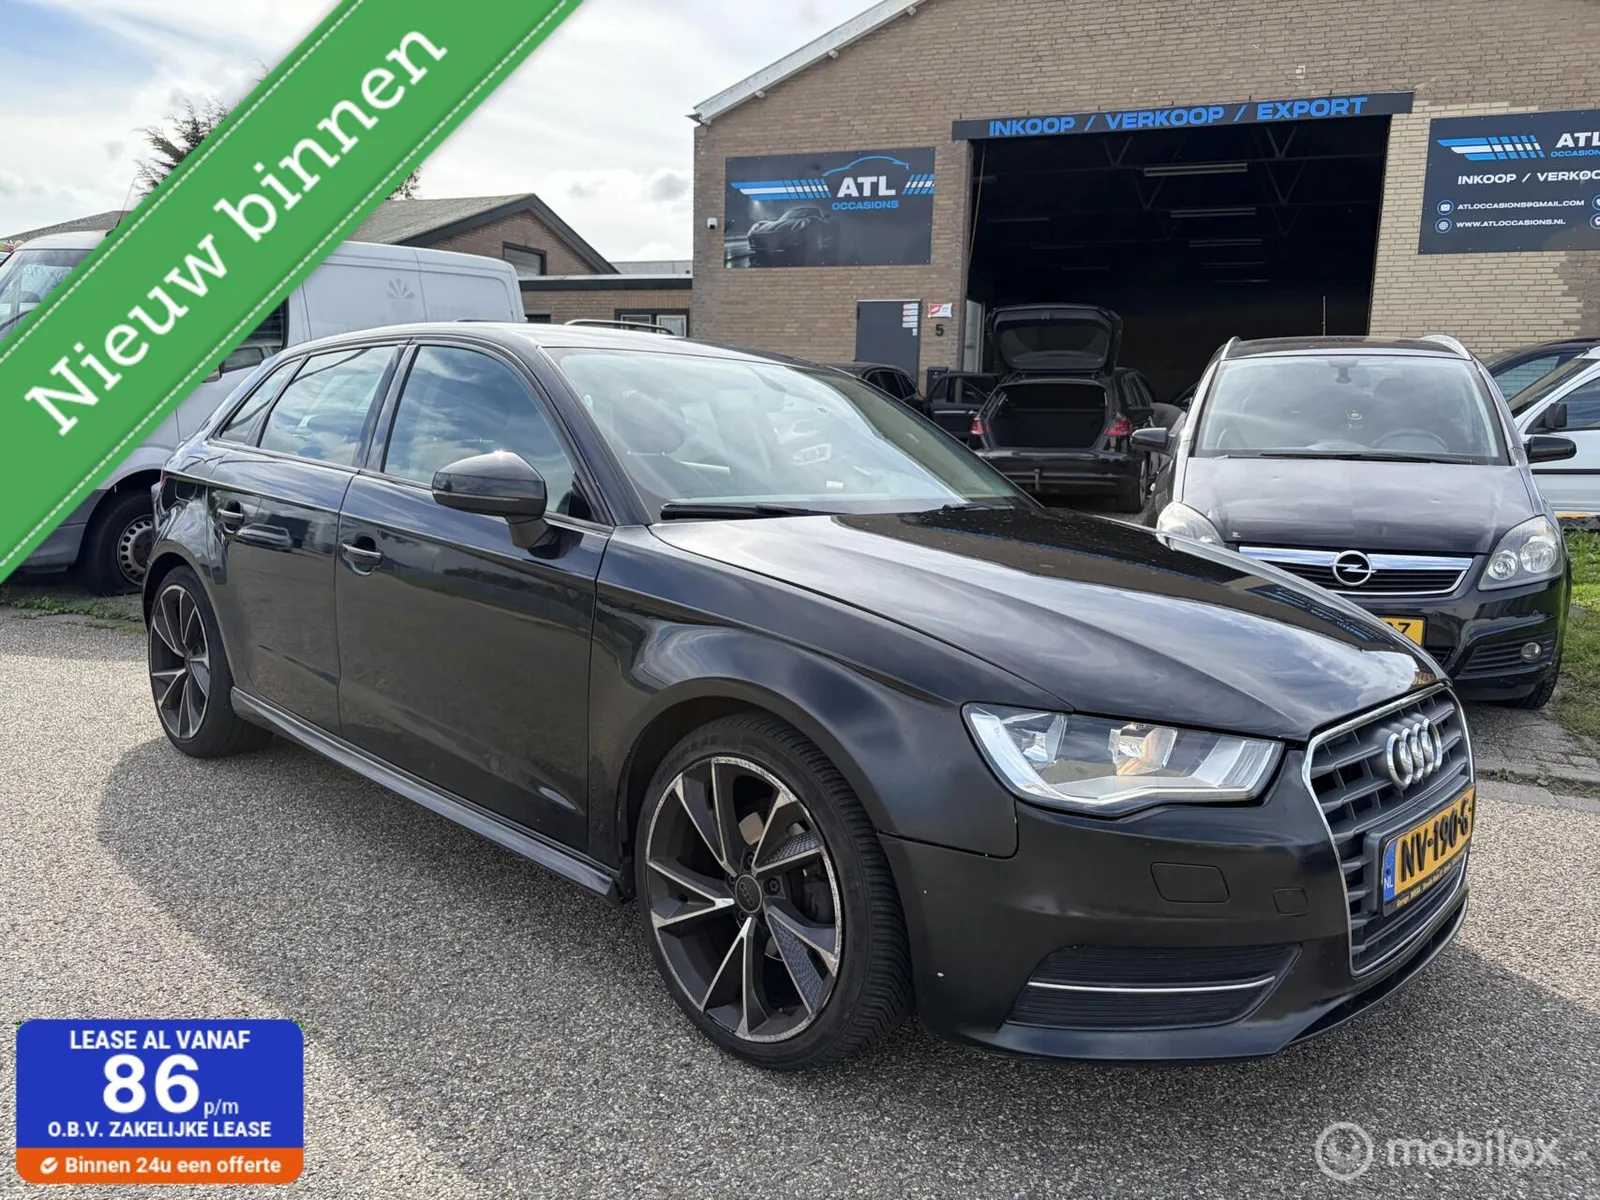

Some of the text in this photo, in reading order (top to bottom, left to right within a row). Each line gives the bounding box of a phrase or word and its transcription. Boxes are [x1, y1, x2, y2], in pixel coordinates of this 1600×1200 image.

[989, 97, 1368, 136] INKOOP / VERKOOP / EXPORT
[1457, 173, 1517, 185] INKOOP
[1522, 173, 1531, 183] /
[836, 175, 896, 198] ATL
[831, 200, 899, 211] OCCASIONS
[1456, 219, 1566, 228] WWW.ATLOCCASIONS.NL
[935, 323, 944, 336] 5
[1384, 876, 1394, 890] NL
